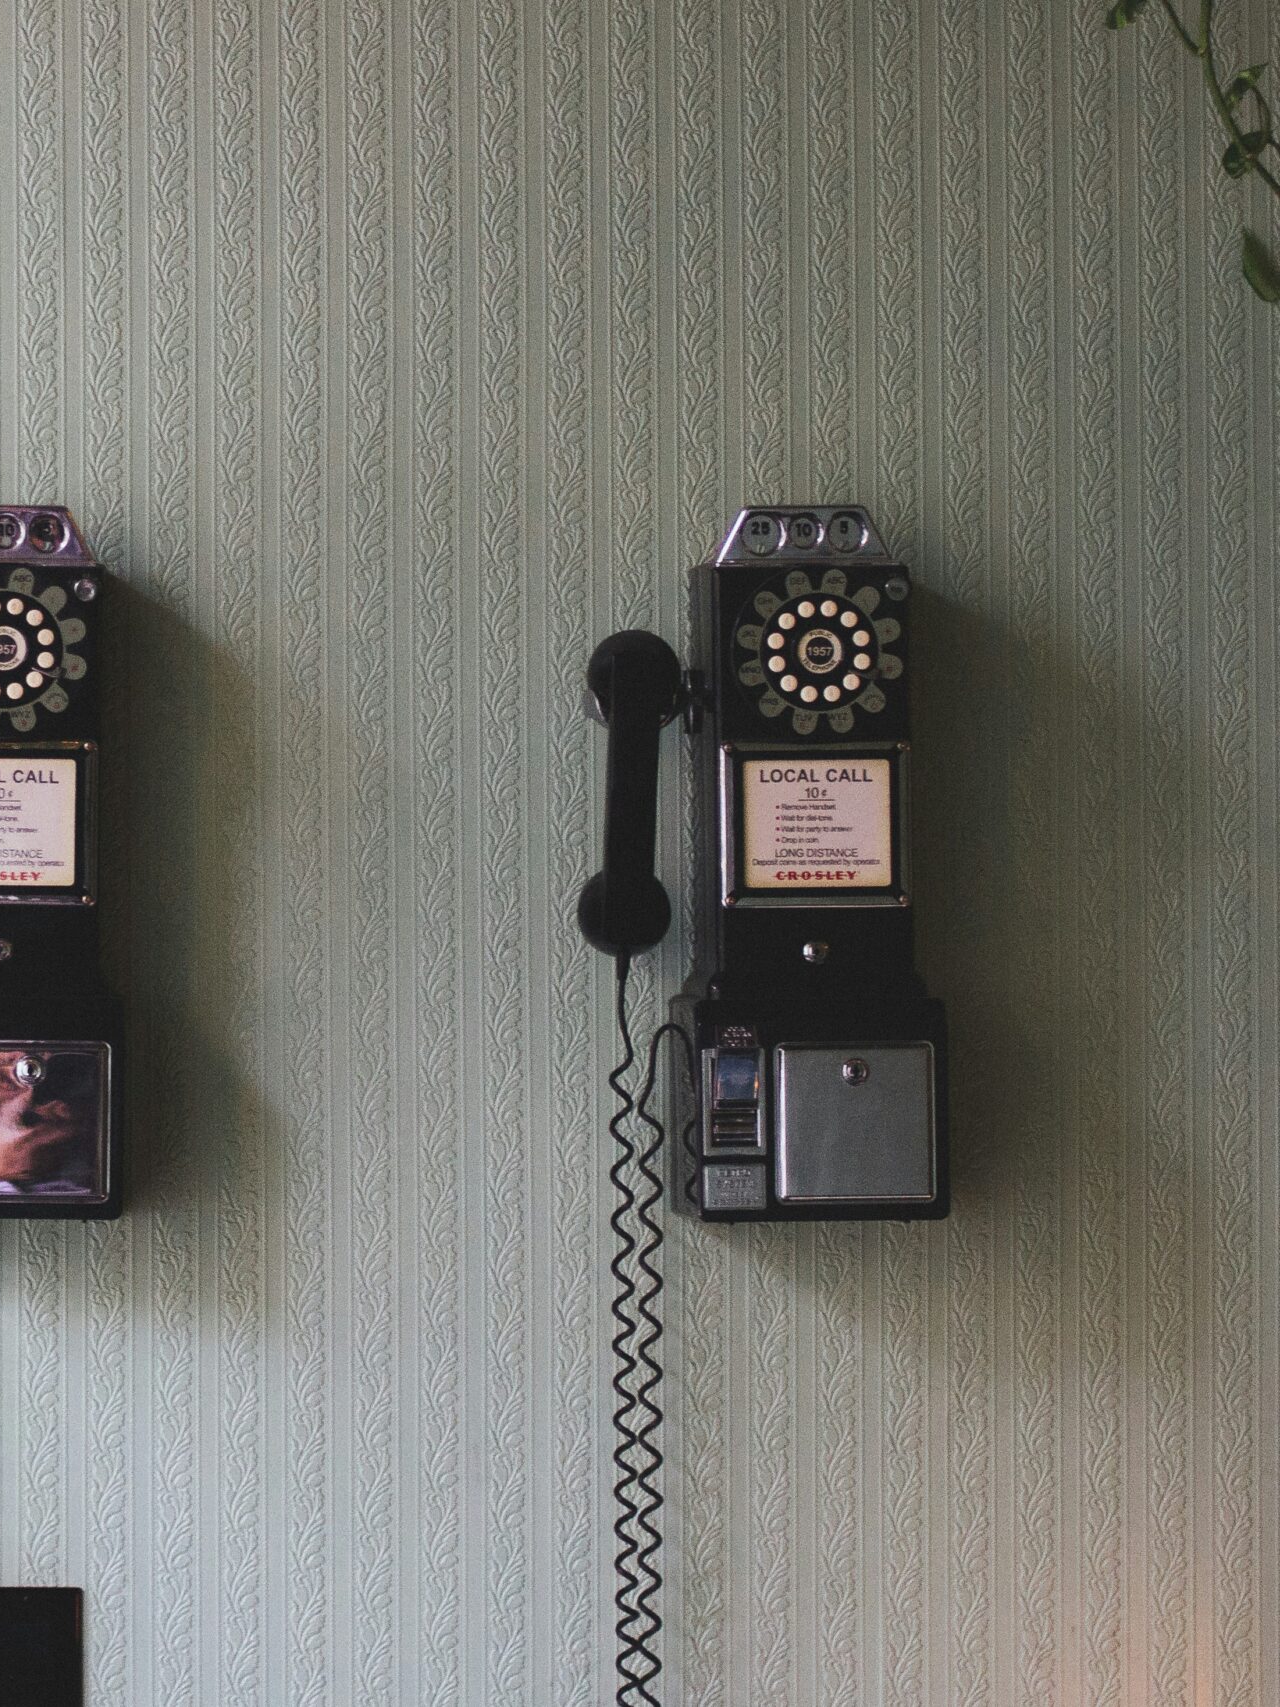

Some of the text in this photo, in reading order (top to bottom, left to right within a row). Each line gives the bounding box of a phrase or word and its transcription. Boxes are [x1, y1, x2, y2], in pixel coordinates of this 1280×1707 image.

[751, 520, 849, 537] 25 10 5
[807, 646, 833, 657] 1957
[803, 658, 836, 671] TELEPHONE
[13, 769, 59, 784] CALL
[759, 768, 873, 783] LOCAL CALL
[775, 848, 859, 858] LONG DISTANCE
[752, 858, 778, 866] Deposit
[842, 859, 851, 867] by
[776, 870, 857, 881] CROSLEY
